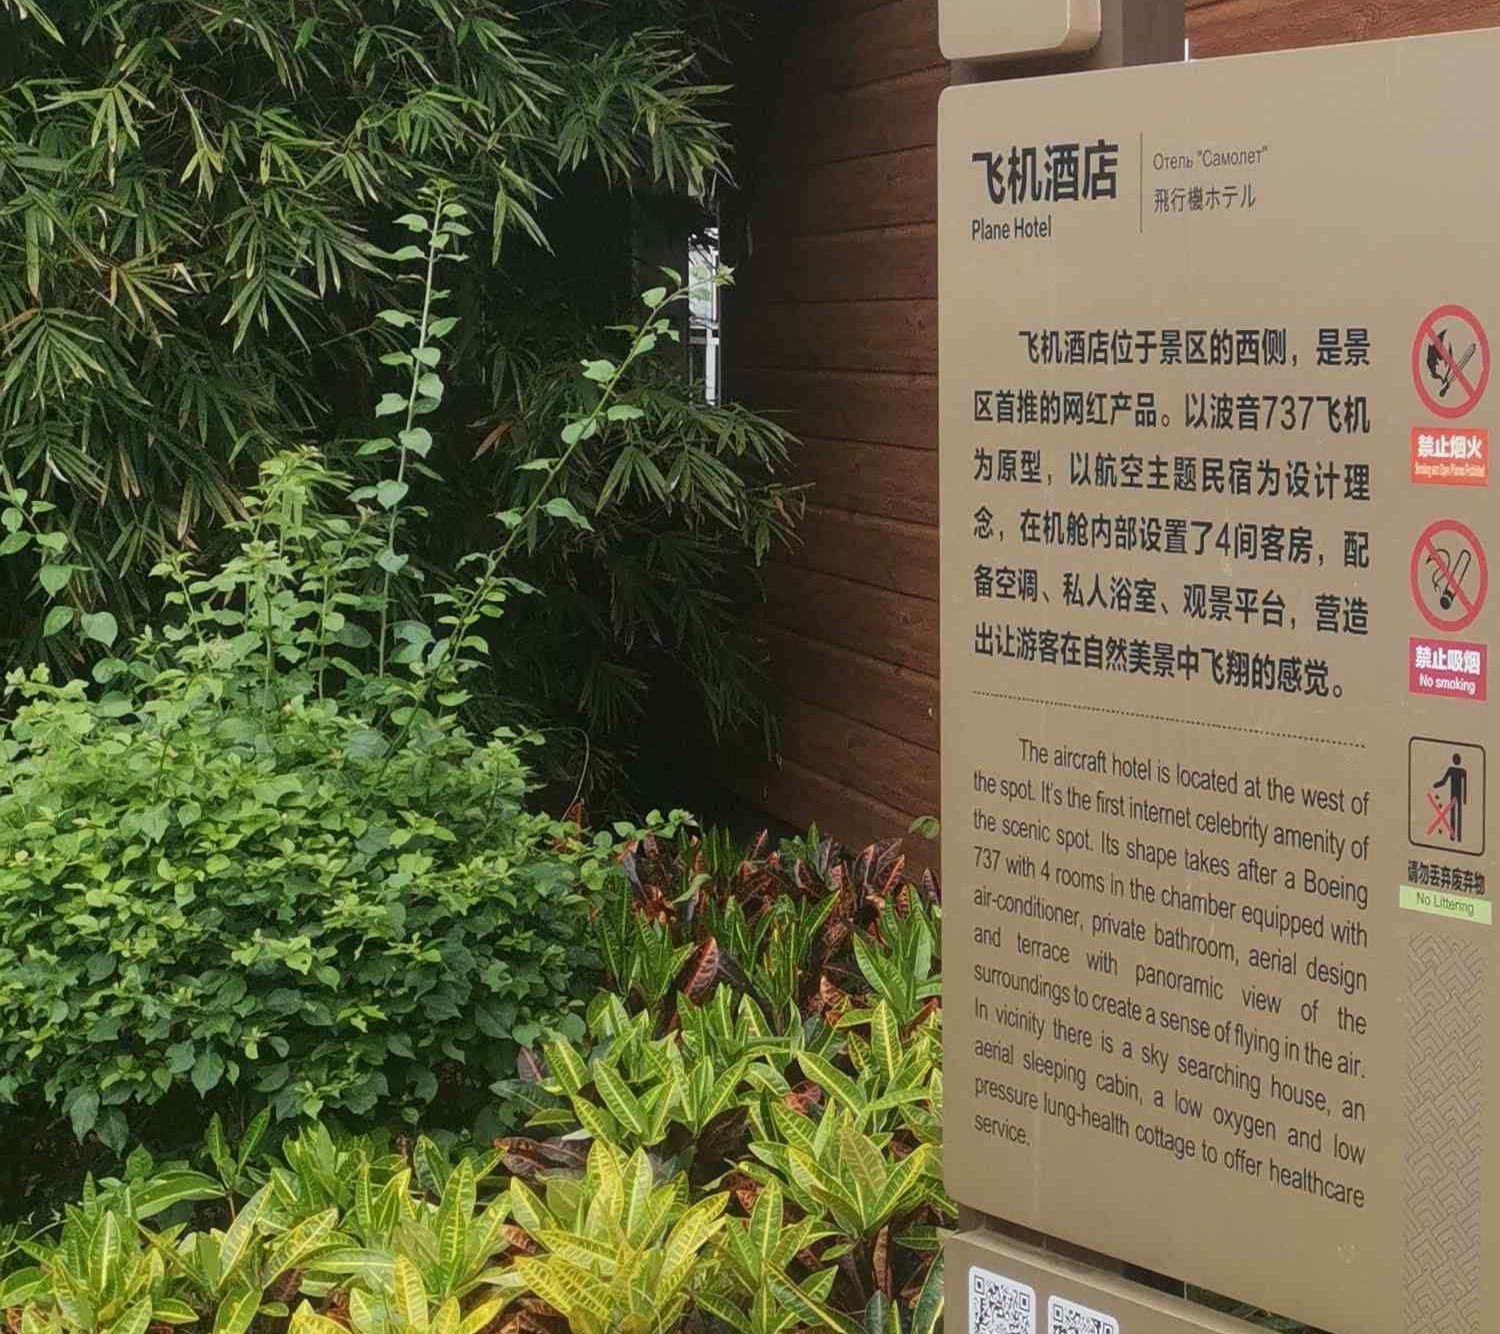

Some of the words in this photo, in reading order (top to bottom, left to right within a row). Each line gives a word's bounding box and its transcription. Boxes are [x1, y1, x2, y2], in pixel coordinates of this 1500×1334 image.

[972, 138, 1119, 205] 飞机酒店
[1153, 153, 1193, 170] Отель
[1153, 183, 1256, 213] 飛行機ホテル
[972, 218, 1010, 240] Plane
[1014, 215, 1052, 238] Hotel
[1417, 434, 1483, 459] 禁止烟火
[1415, 644, 1480, 676] 禁止吸烟
[1419, 673, 1434, 688] No
[1435, 677, 1476, 696] smoking
[973, 770, 997, 795] the
[999, 778, 1037, 804] spot.
[1041, 779, 1063, 807] It's
[1066, 785, 1092, 812] the
[1095, 789, 1126, 818] first
[1128, 795, 1193, 830] internet
[1195, 810, 1270, 849] celebrity
[1273, 826, 1347, 863] amenity
[1350, 834, 1371, 861] of
[1018, 737, 1049, 765] The
[1053, 744, 1108, 774] aircraft
[1111, 751, 1152, 782] hotel
[1156, 758, 1171, 785] is
[1176, 762, 1238, 795] located
[1244, 775, 1262, 800] at
[1266, 776, 1296, 805] the
[1300, 787, 1345, 813] west
[1350, 790, 1371, 817] of
[973, 808, 997, 833] the
[1001, 818, 1051, 844] scenic
[1055, 827, 1094, 853] spot.
[1101, 829, 1120, 857] Its
[1125, 836, 1178, 871] shape
[1183, 847, 1231, 878] takes
[1237, 857, 1279, 887] after
[1283, 870, 1296, 890] a
[1303, 867, 1369, 911] Boeing
[973, 845, 1002, 872] 737
[1005, 854, 1036, 879] with
[1040, 859, 1051, 882] 4
[1055, 867, 1105, 894] rooms
[1110, 872, 1125, 898] in
[1128, 877, 1156, 904] the
[1160, 884, 1237, 921] chamber
[1240, 904, 1325, 940] equipped
[1330, 919, 1368, 948] with
[1416, 892, 1431, 906] No
[973, 884, 1084, 932] air-conditioner,
[1091, 911, 1147, 942] private
[1154, 921, 1239, 967] bathroom,
[1247, 947, 1297, 976] aerial
[1305, 955, 1368, 996] design
[973, 925, 1002, 948] and
[1016, 931, 1070, 964] terrace
[1085, 949, 1118, 976] with
[1135, 964, 1224, 1001] panoramic
[1241, 984, 1283, 1015] view
[1300, 998, 1320, 1024] of
[1337, 1005, 1368, 1036] the
[973, 963, 1071, 1007] surroundings
[1073, 984, 1089, 1008] to
[1091, 993, 1143, 1022] create
[1145, 1006, 1156, 1026] a
[1159, 1010, 1211, 1039] sense
[1214, 1020, 1232, 1045] of
[1233, 1022, 1280, 1063] flying
[1284, 1035, 1300, 1062] in
[1303, 1040, 1333, 1070] the
[1337, 1050, 1366, 1079] air.
[974, 996, 989, 1021] In
[995, 1003, 1045, 1041] vicinity
[1052, 1017, 1093, 1049] there
[1100, 1029, 1114, 1055] is
[1121, 1041, 1133, 1060] a
[1140, 1042, 1170, 1075] sky
[1177, 1055, 1261, 1100] searching
[1270, 1073, 1331, 1117] house,
[1341, 1099, 1366, 1123] an
[974, 1039, 1014, 1066] aerial
[1022, 1049, 1087, 1092] sleeping
[1095, 1072, 1143, 1106] cabin,
[1153, 1089, 1165, 1109] a
[1174, 1088, 1203, 1119] low
[1212, 1106, 1277, 1141] oxygen
[1287, 1127, 1322, 1154] and
[1333, 1132, 1366, 1166] low
[974, 1114, 1031, 1147] service.
[975, 1076, 1039, 1111] pressure
[1043, 1091, 1130, 1139] lung-health
[1134, 1123, 1196, 1161] cottage
[1201, 1138, 1218, 1164] to
[1223, 1147, 1264, 1178] offer
[1269, 1157, 1365, 1209] healthcare
